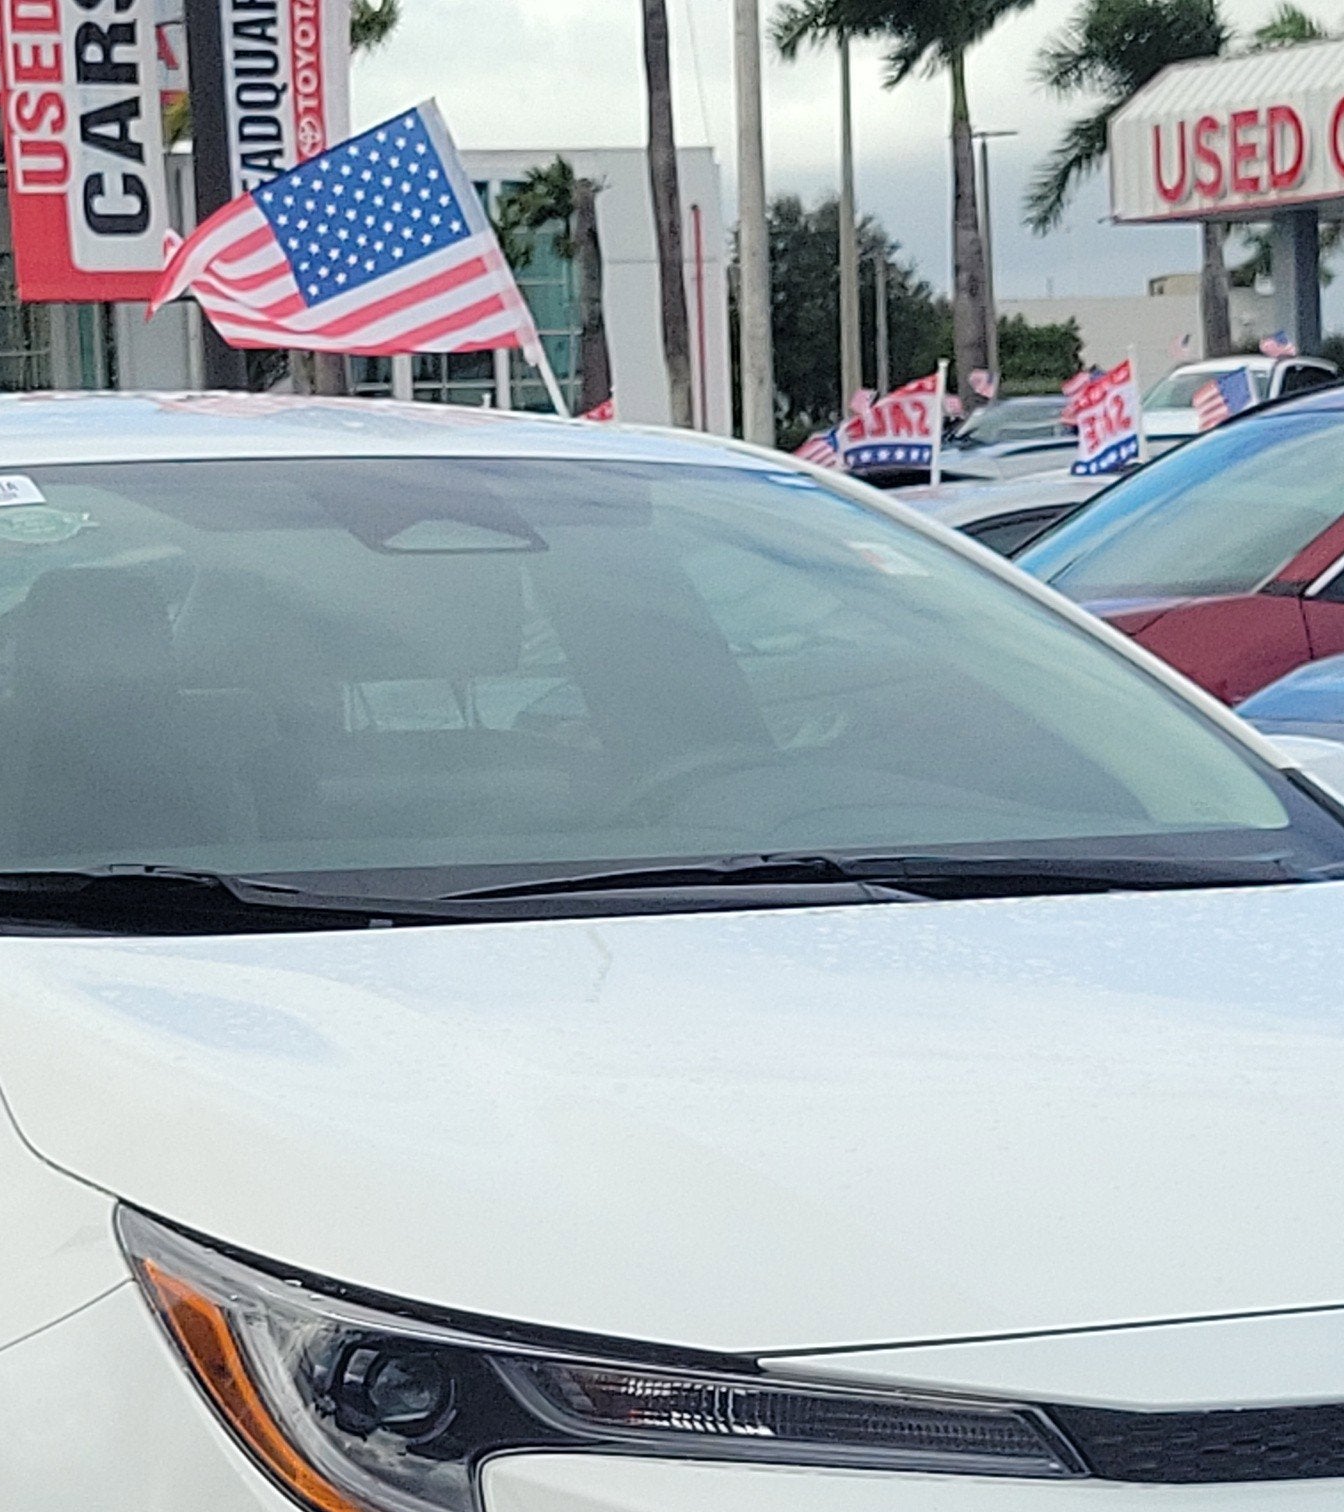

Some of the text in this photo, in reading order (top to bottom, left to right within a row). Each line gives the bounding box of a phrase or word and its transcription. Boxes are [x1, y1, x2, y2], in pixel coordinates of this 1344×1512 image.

[10, 0, 72, 188] USED
[75, 0, 152, 236] CAR
[1153, 105, 1306, 203] USED
